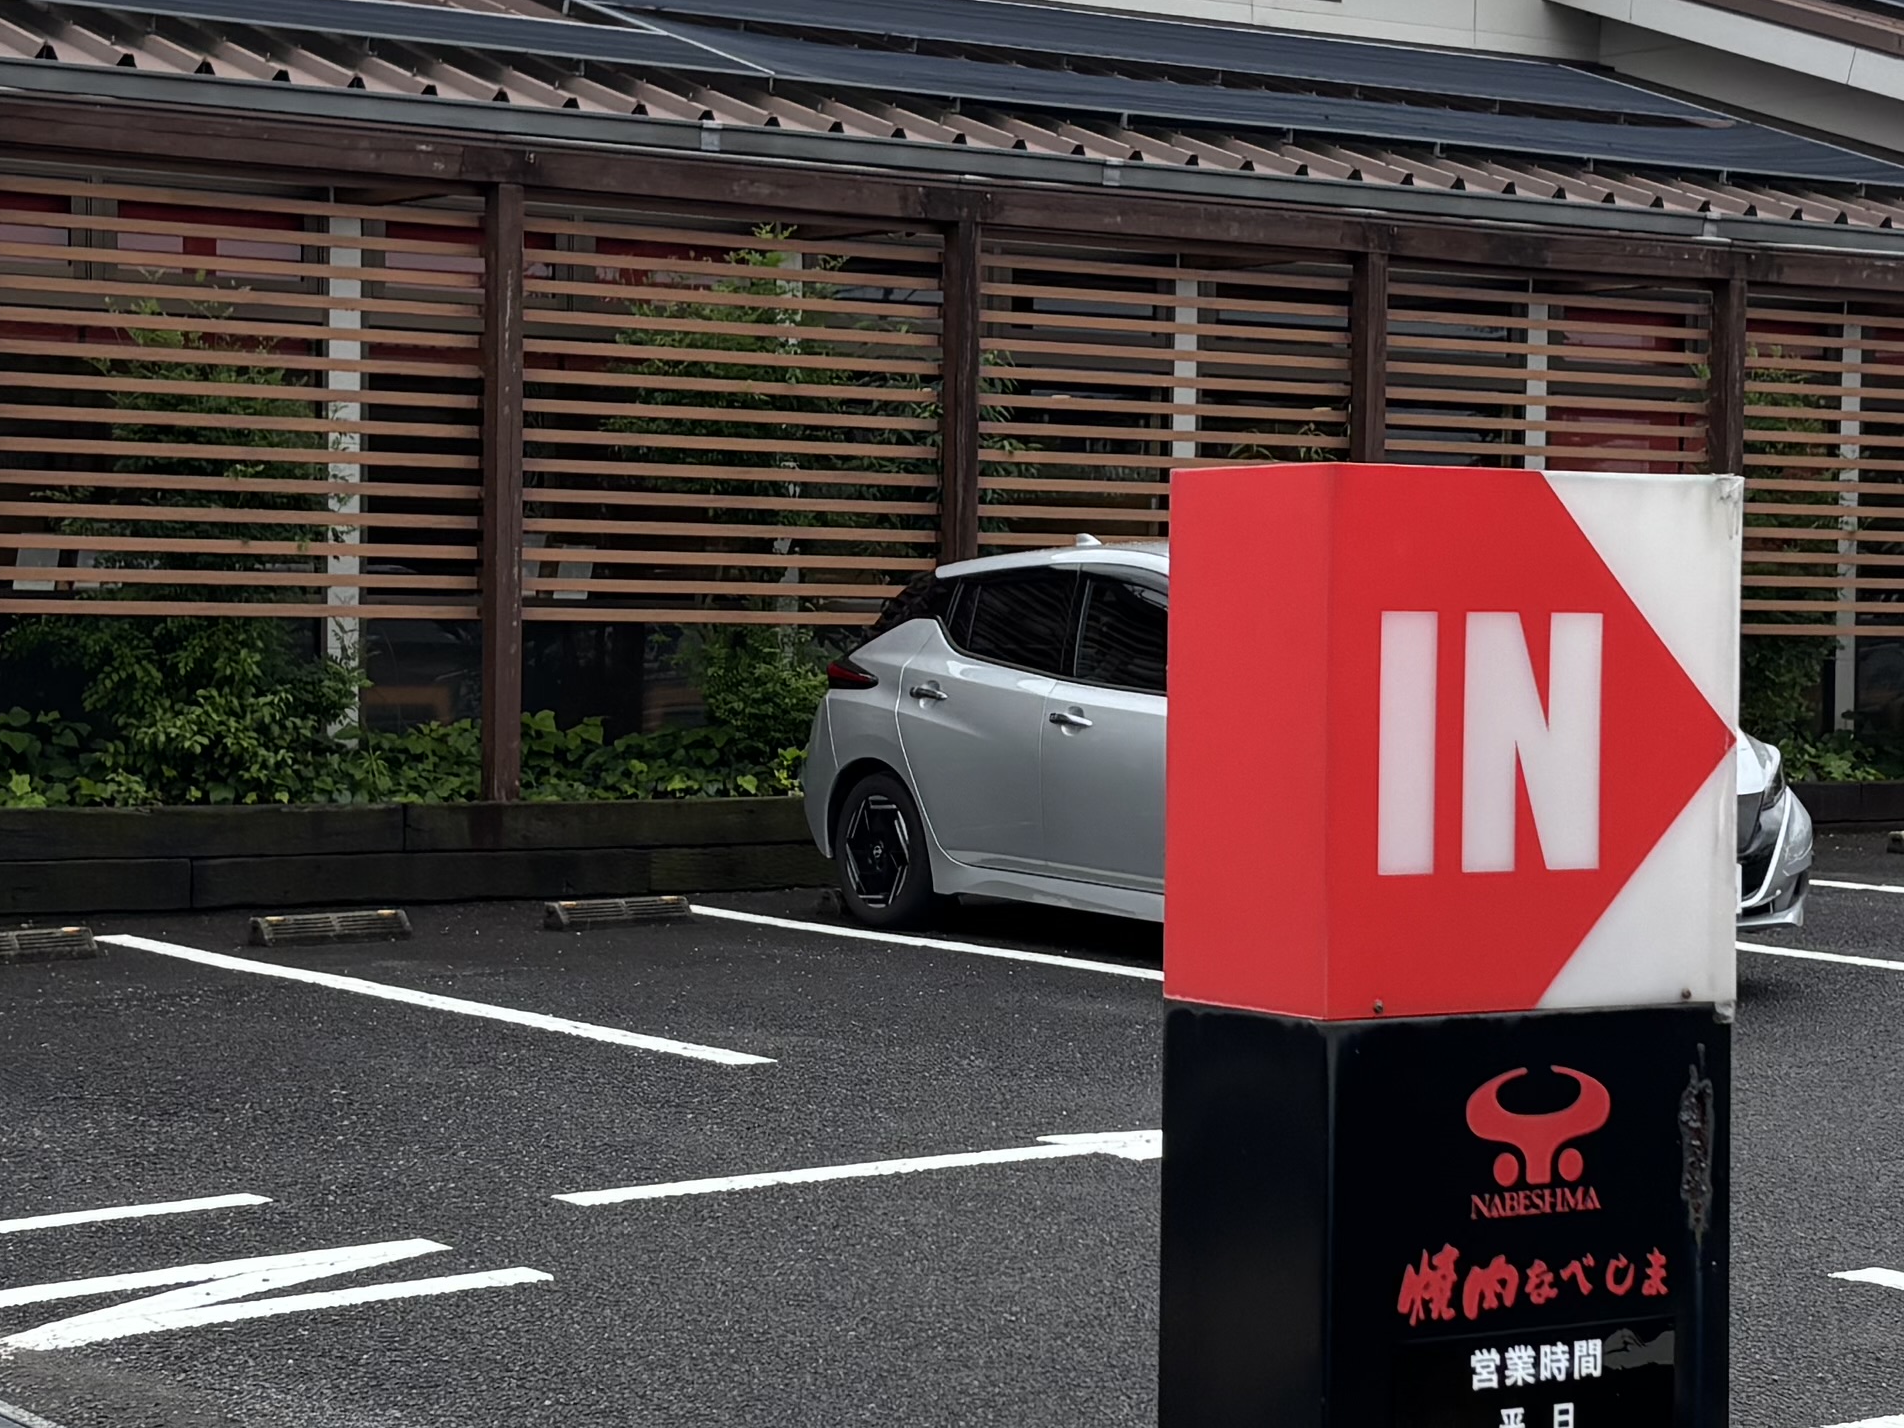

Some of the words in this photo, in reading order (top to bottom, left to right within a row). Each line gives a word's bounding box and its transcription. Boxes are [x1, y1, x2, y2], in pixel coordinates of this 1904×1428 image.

[1377, 610, 1604, 876] IN
[1397, 1243, 1669, 1327] 焼肉なべしま
[1470, 1338, 1603, 1391] 営業時間
